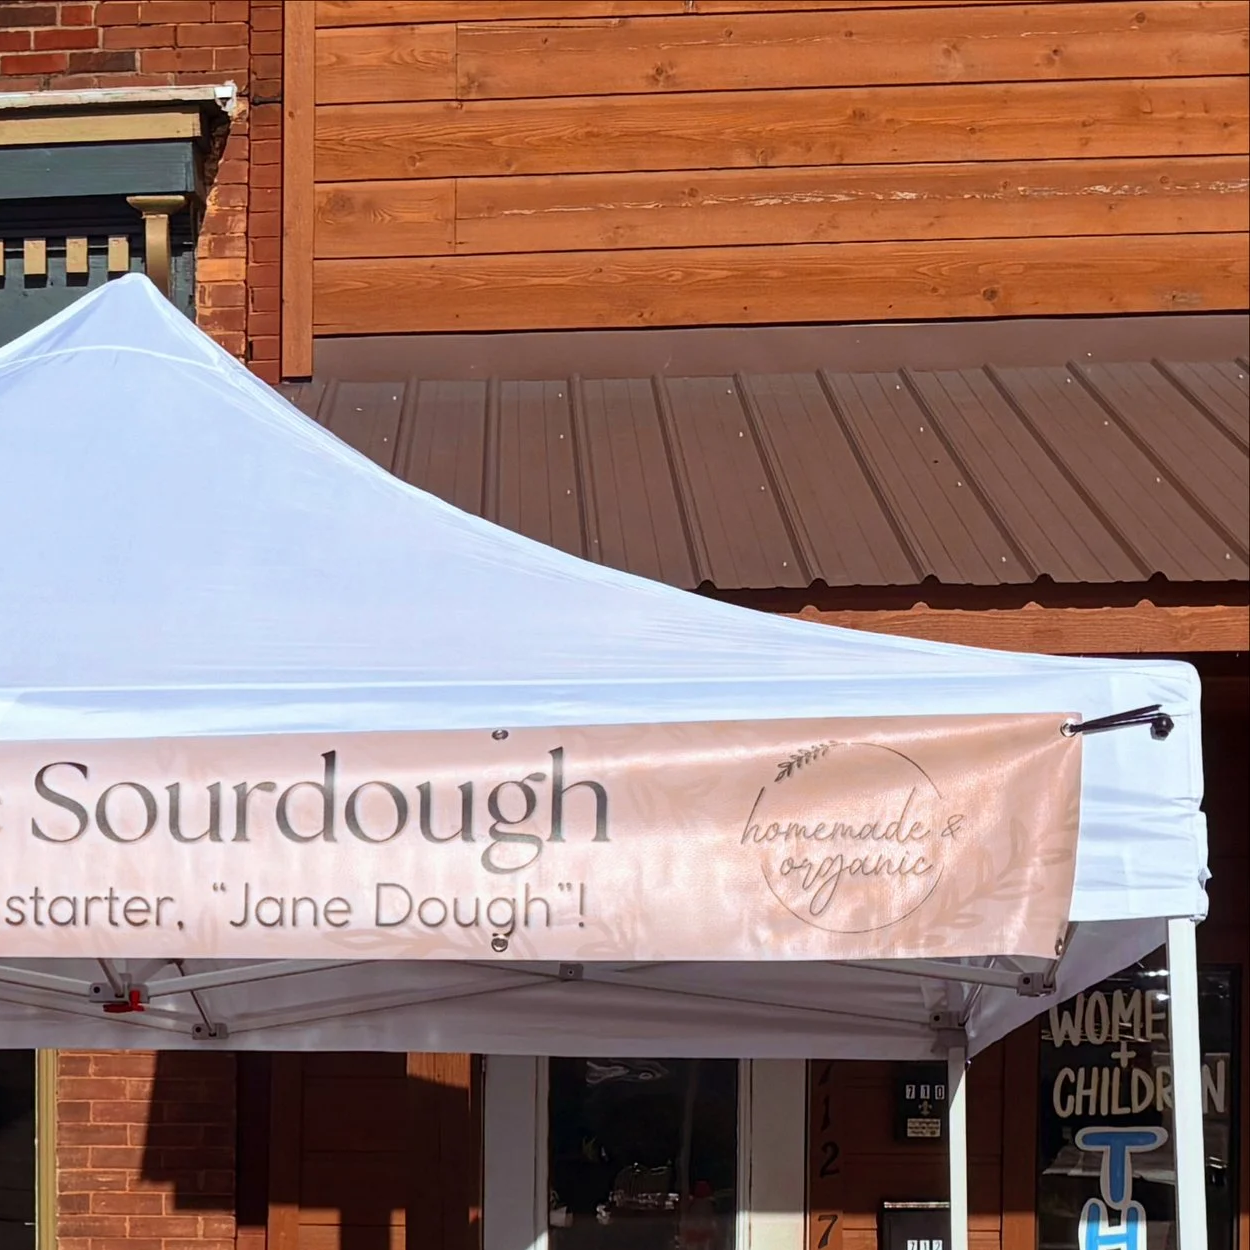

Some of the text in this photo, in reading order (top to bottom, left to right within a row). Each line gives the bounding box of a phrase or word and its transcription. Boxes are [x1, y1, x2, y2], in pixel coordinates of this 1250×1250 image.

[31, 747, 610, 875] Sourdough
[741, 786, 964, 844] homemade &
[5, 886, 184, 931] starter,
[213, 881, 350, 929] “Jane
[780, 851, 933, 916] organic
[1050, 988, 1173, 1048] WOME
[906, 1084, 945, 1100] 710
[1052, 1060, 1226, 1118] CHILDRN
